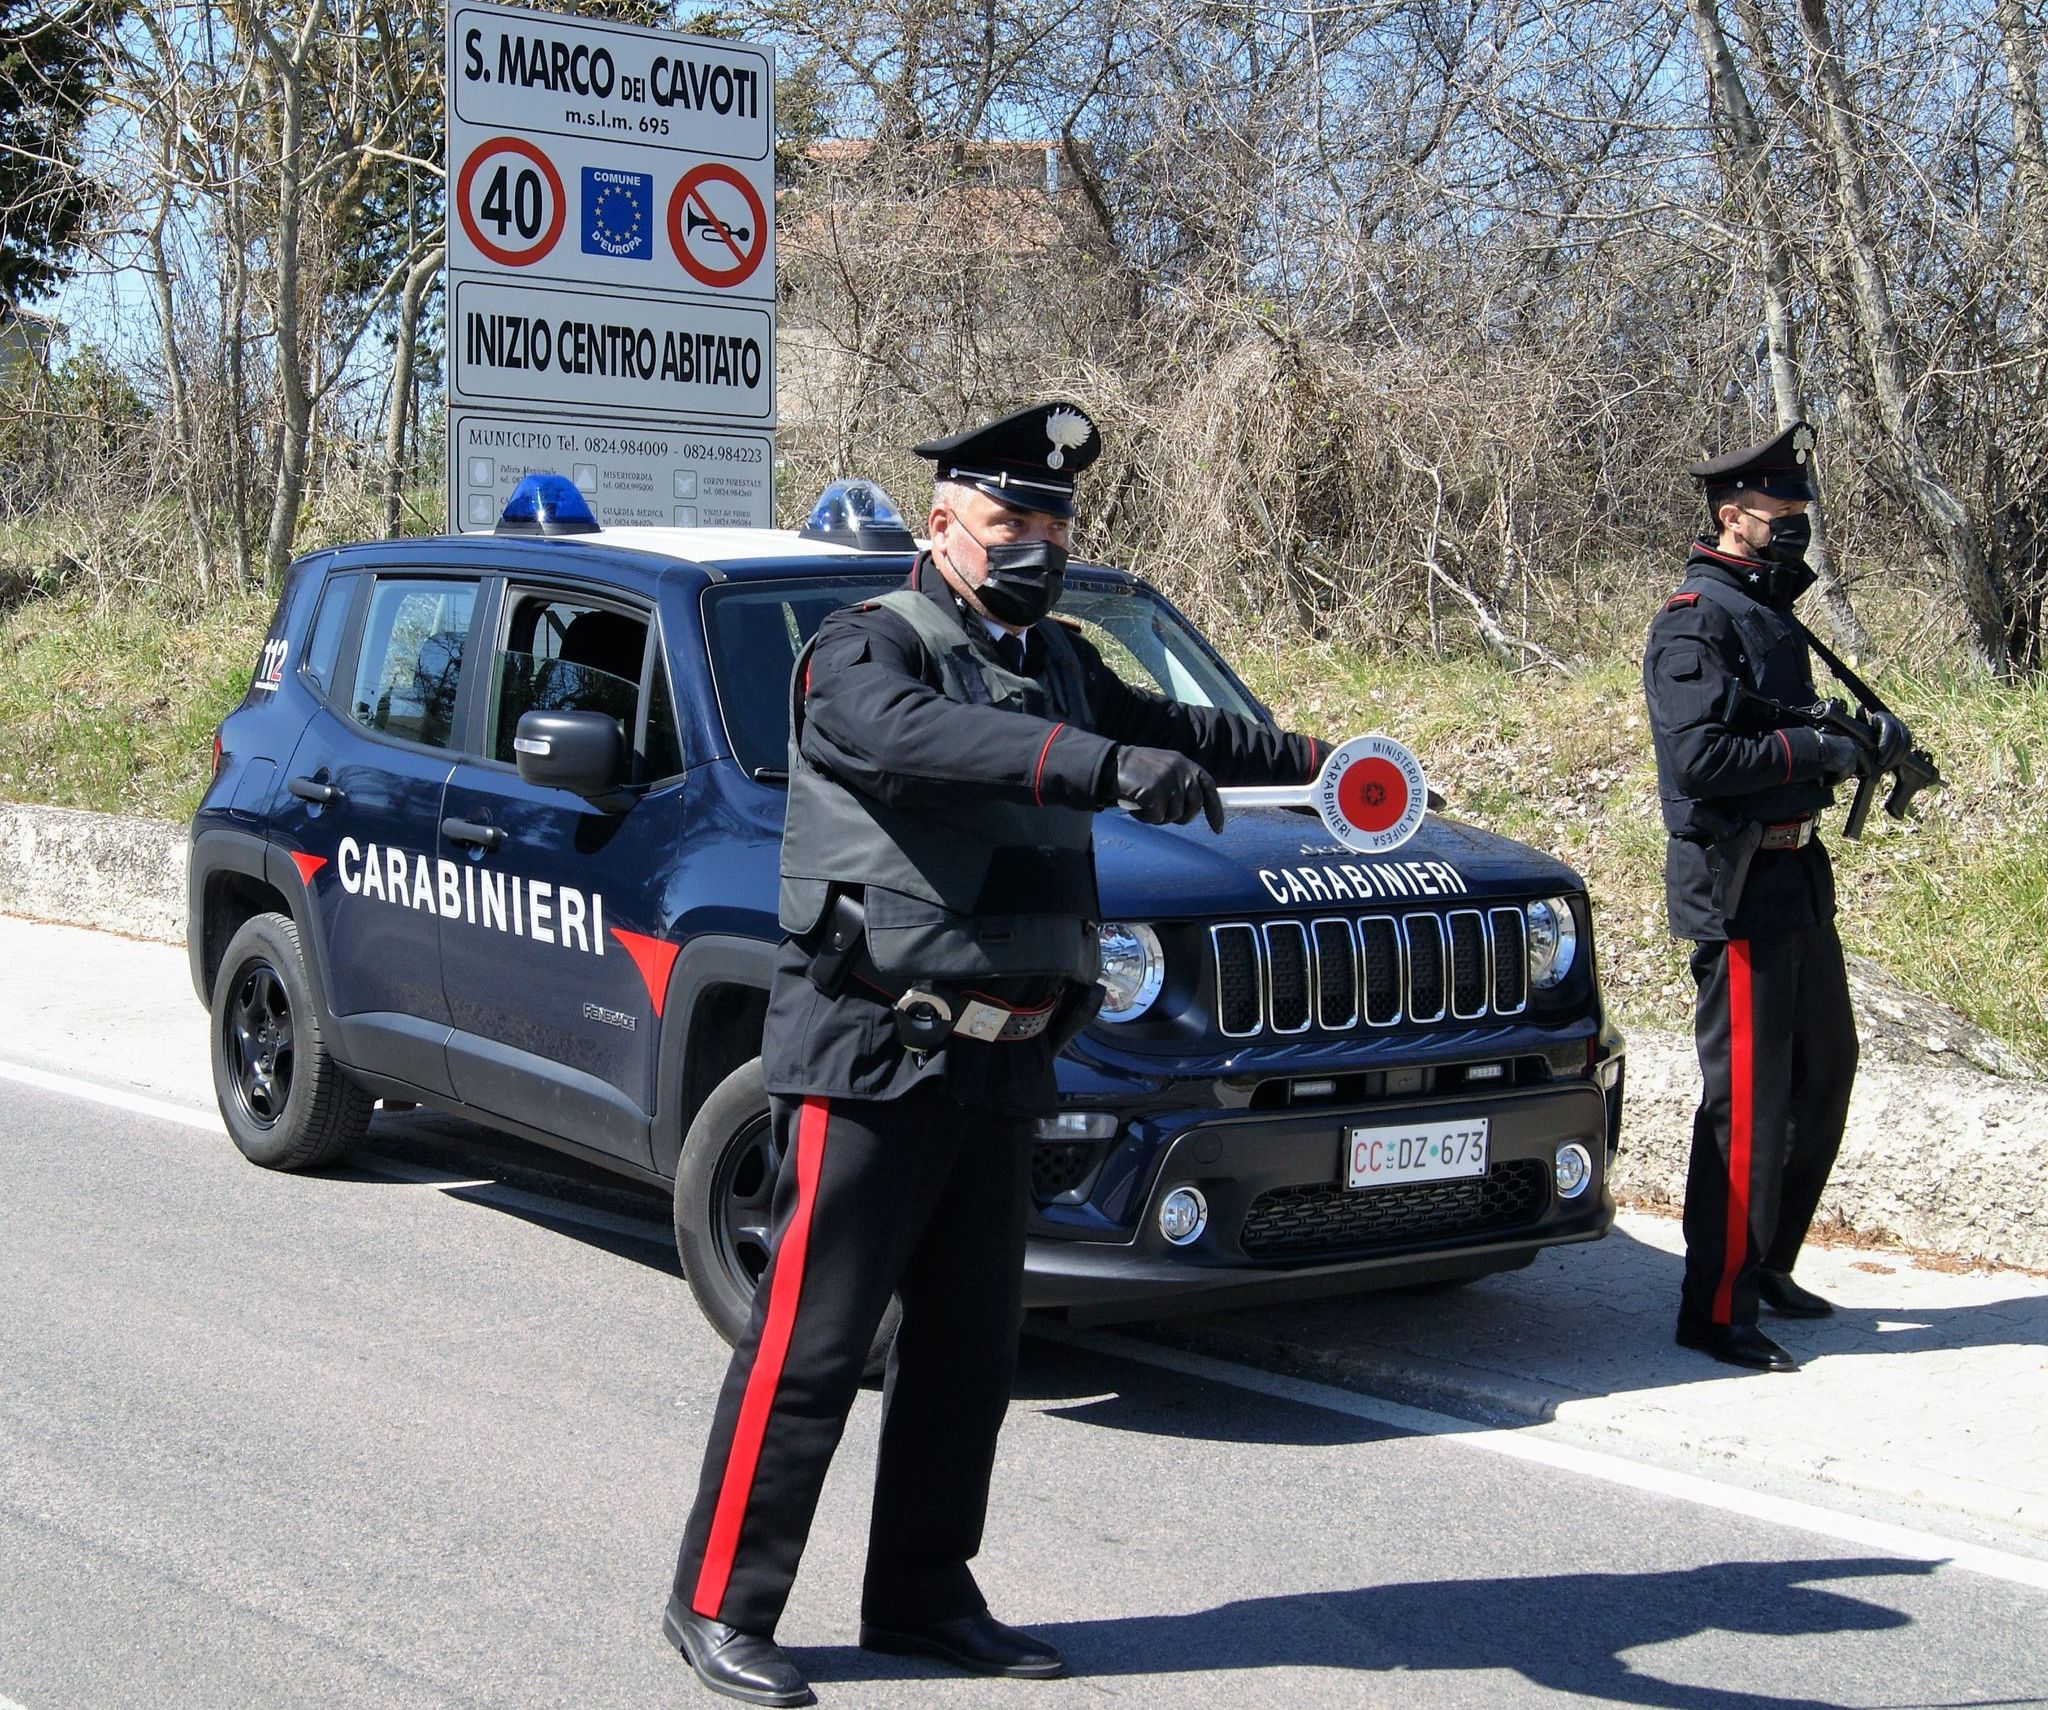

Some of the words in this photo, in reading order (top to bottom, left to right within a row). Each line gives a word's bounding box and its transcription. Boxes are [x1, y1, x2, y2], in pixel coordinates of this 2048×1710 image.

[464, 28, 491, 83] S.
[498, 33, 615, 99] MARCO
[621, 76, 646, 103] DEI
[650, 56, 758, 119] CAVOTI
[565, 109, 633, 131] m.s.l.m.
[638, 118, 670, 136] 695
[593, 171, 641, 187] COMUNE
[480, 165, 543, 240] 40
[591, 229, 643, 256] D'EUROPA
[467, 312, 552, 372] INIZIO
[557, 320, 657, 380] CENTRO
[660, 330, 761, 389] ABITATO
[469, 429, 551, 450] MUNICIPIO
[556, 435, 579, 452] Tel.
[584, 437, 668, 457] 0824.984009
[683, 443, 762, 464] 0824.984223
[260, 638, 289, 682] 112
[1372, 742, 1420, 785] MINISTERO
[1323, 752, 1352, 838] CARABINIERI
[1405, 788, 1422, 823] DELLA
[1372, 823, 1408, 847] DIFESA
[337, 835, 606, 957] CARABINIERI
[1258, 860, 1469, 905] CARABINIERI
[1441, 1131, 1484, 1165] 673
